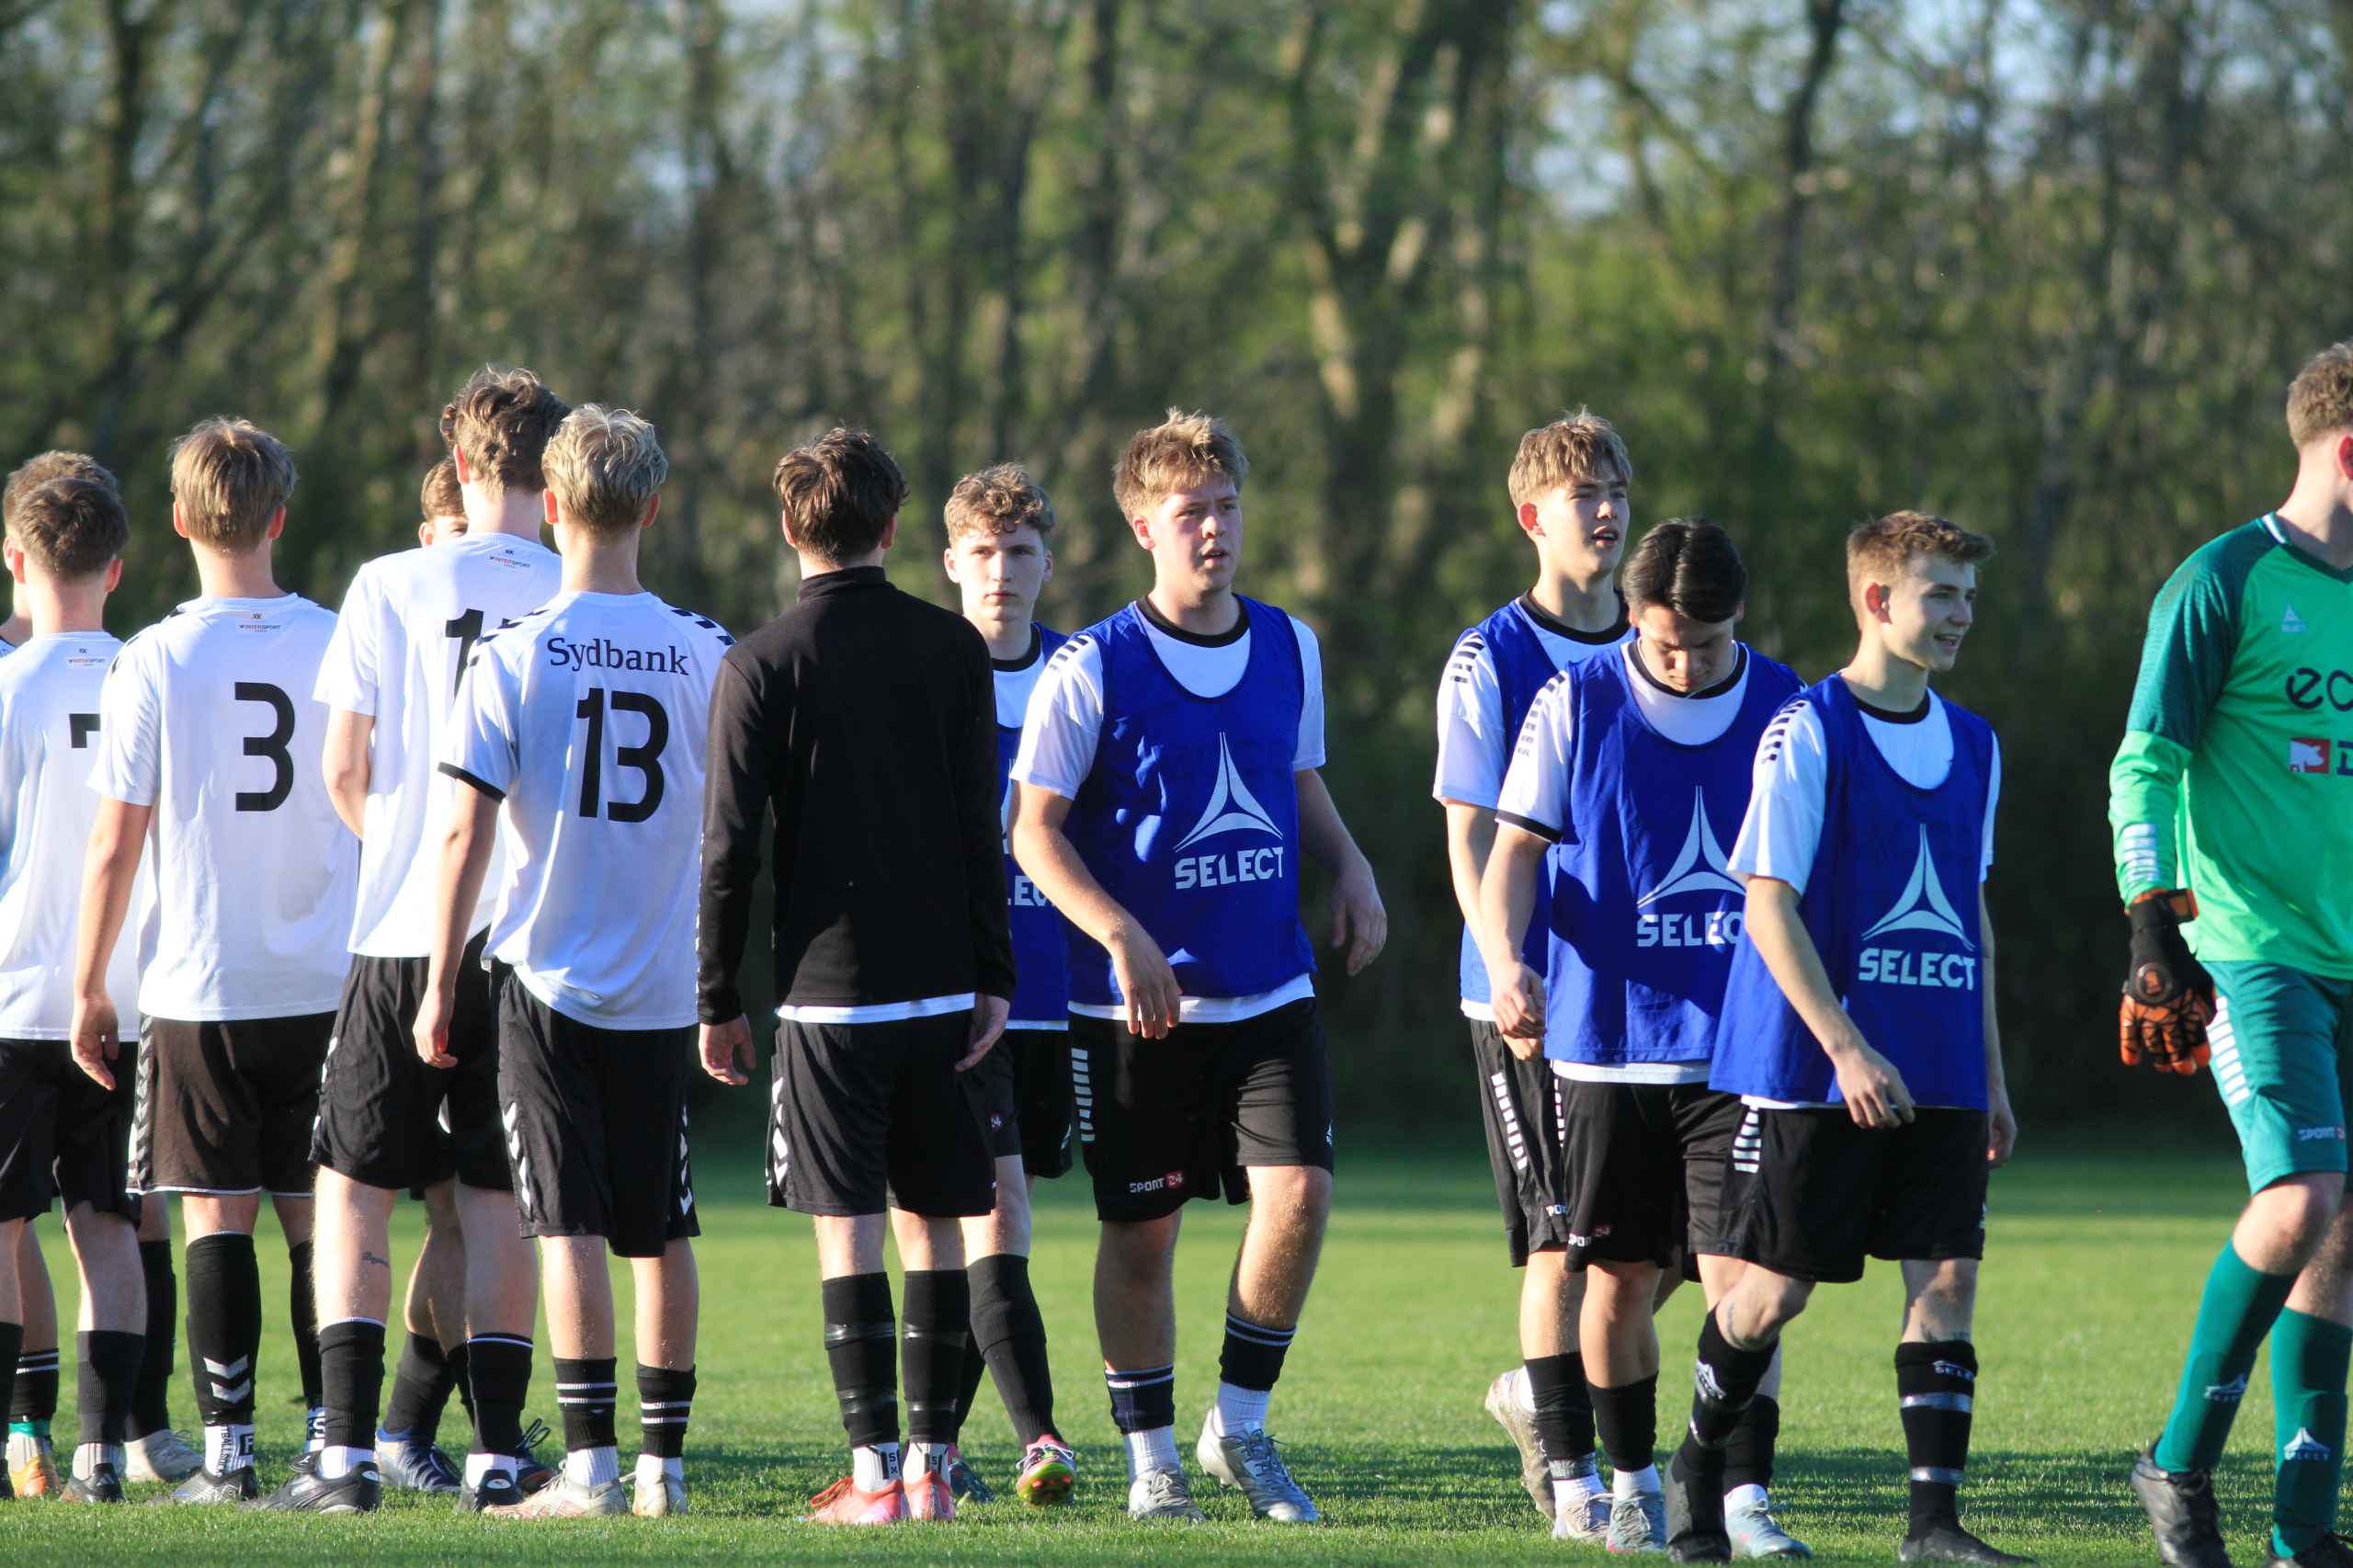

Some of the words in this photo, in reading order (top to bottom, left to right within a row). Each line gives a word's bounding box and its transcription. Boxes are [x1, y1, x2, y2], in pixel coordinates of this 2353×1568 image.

[547, 637, 689, 676] Sydbank
[234, 682, 295, 812] 3
[576, 687, 669, 824] 13
[1174, 846, 1284, 890] SELECT
[1637, 911, 1745, 948] SELEC
[1858, 948, 1976, 991] SELECT
[1130, 1177, 1165, 1193] SPORT
[1168, 1173, 1183, 1186] 24
